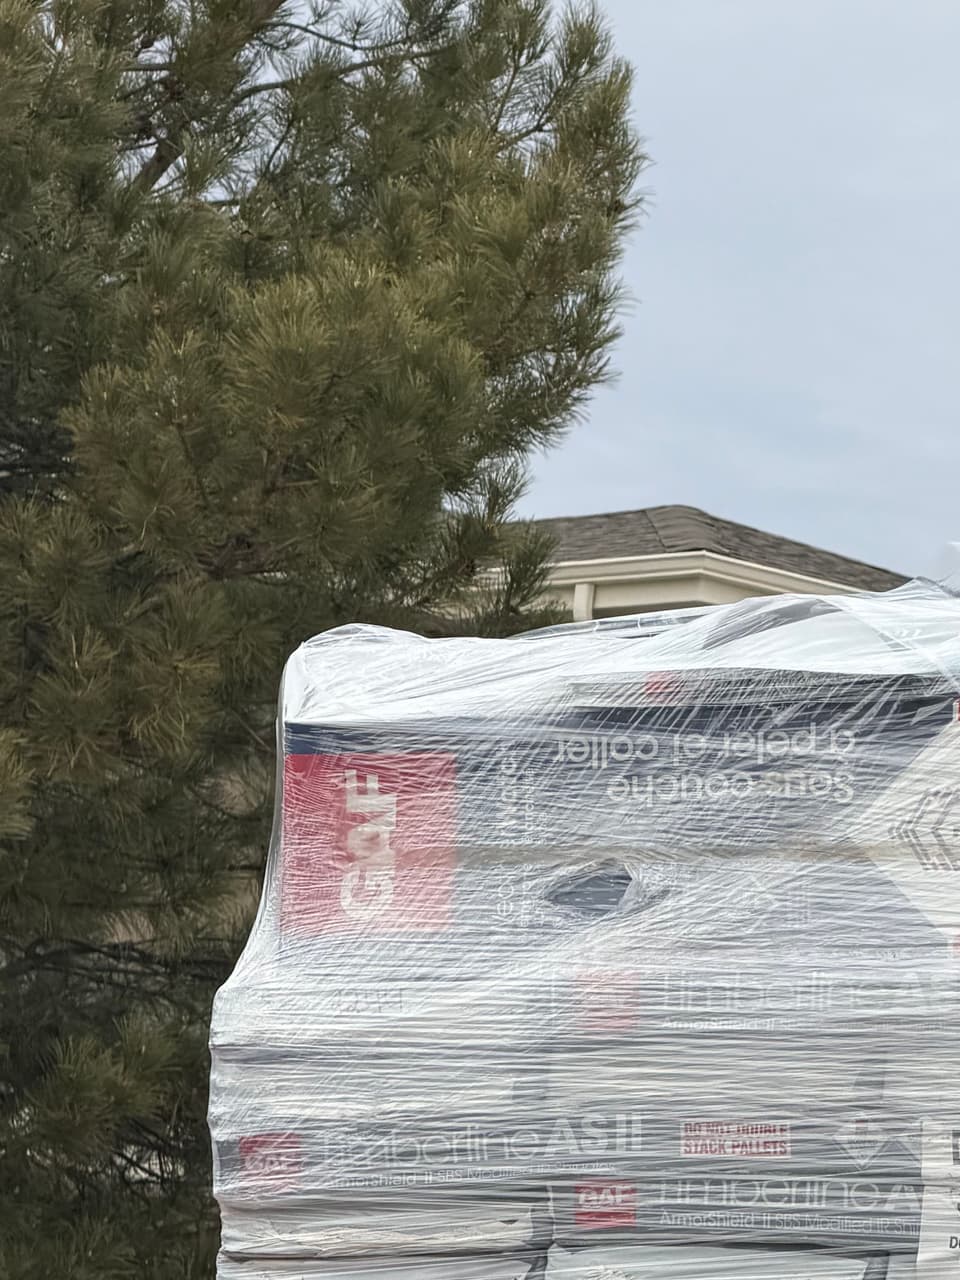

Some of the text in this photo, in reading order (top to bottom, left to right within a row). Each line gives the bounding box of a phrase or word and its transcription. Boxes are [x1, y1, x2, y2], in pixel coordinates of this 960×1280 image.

[554, 736, 658, 769] coller
[339, 769, 397, 918] GAF
[683, 1140, 787, 1155] STACK PALLETS
